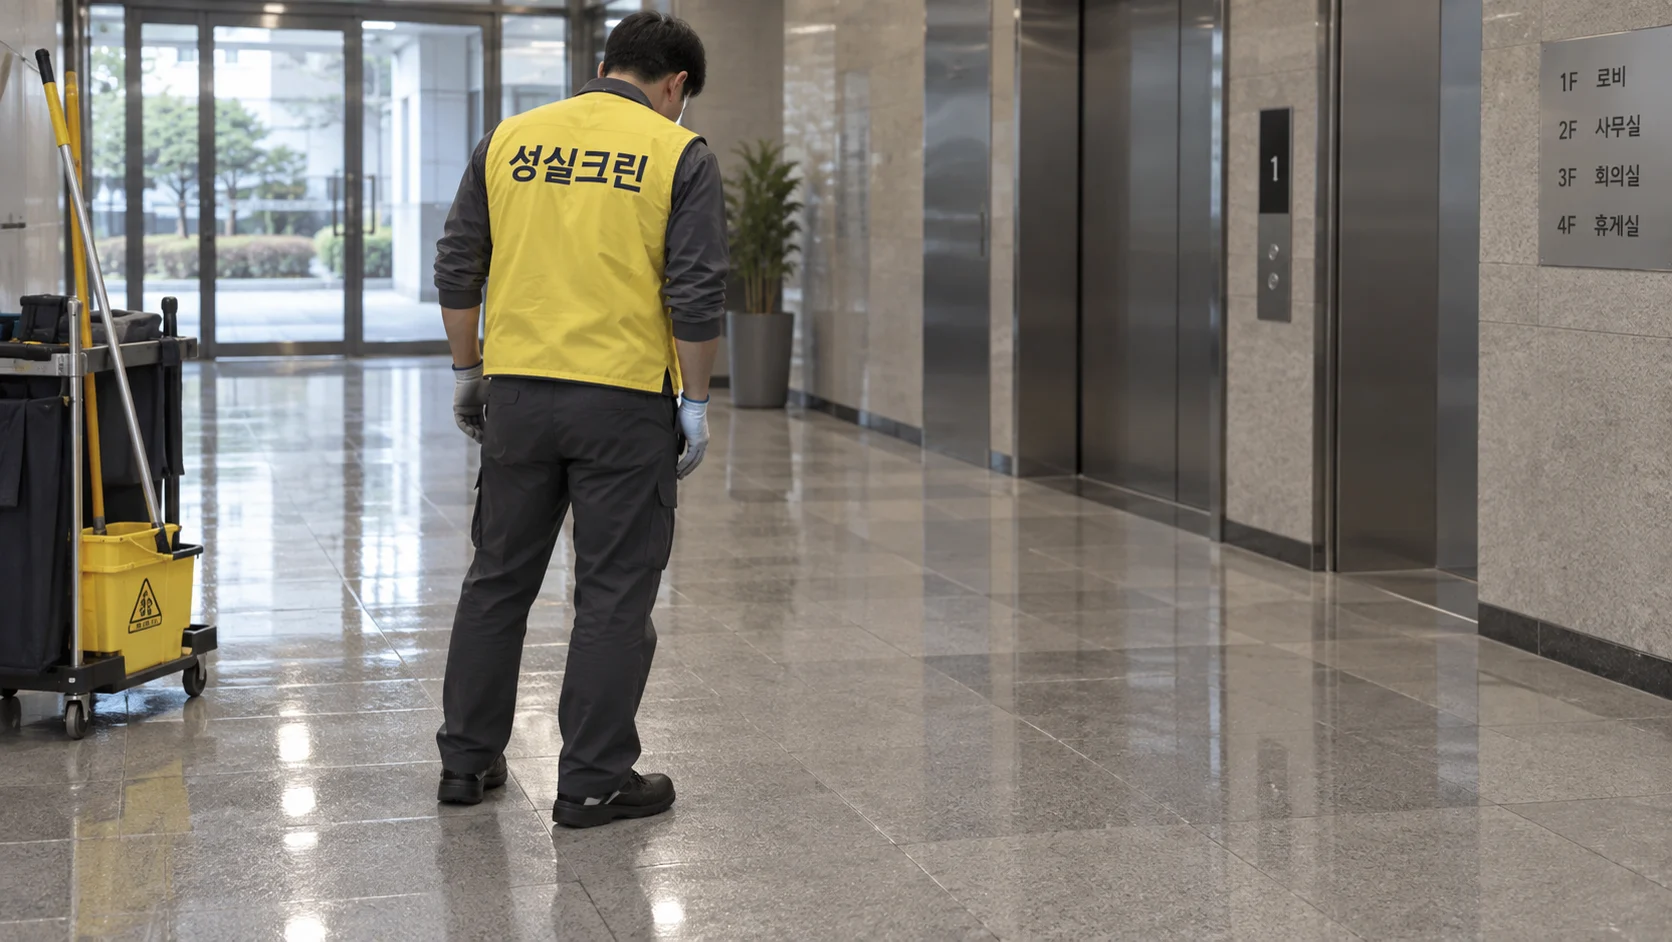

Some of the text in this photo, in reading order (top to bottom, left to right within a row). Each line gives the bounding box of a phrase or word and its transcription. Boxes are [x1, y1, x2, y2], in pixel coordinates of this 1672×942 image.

[1560, 65, 1626, 92] 1F 로비
[1558, 114, 1641, 140] 2F 사무실
[508, 145, 649, 193] 성실크린
[1270, 155, 1279, 182] 1
[1558, 164, 1640, 187] 3F 회의실
[1557, 213, 1639, 237] 4F 휴게실
